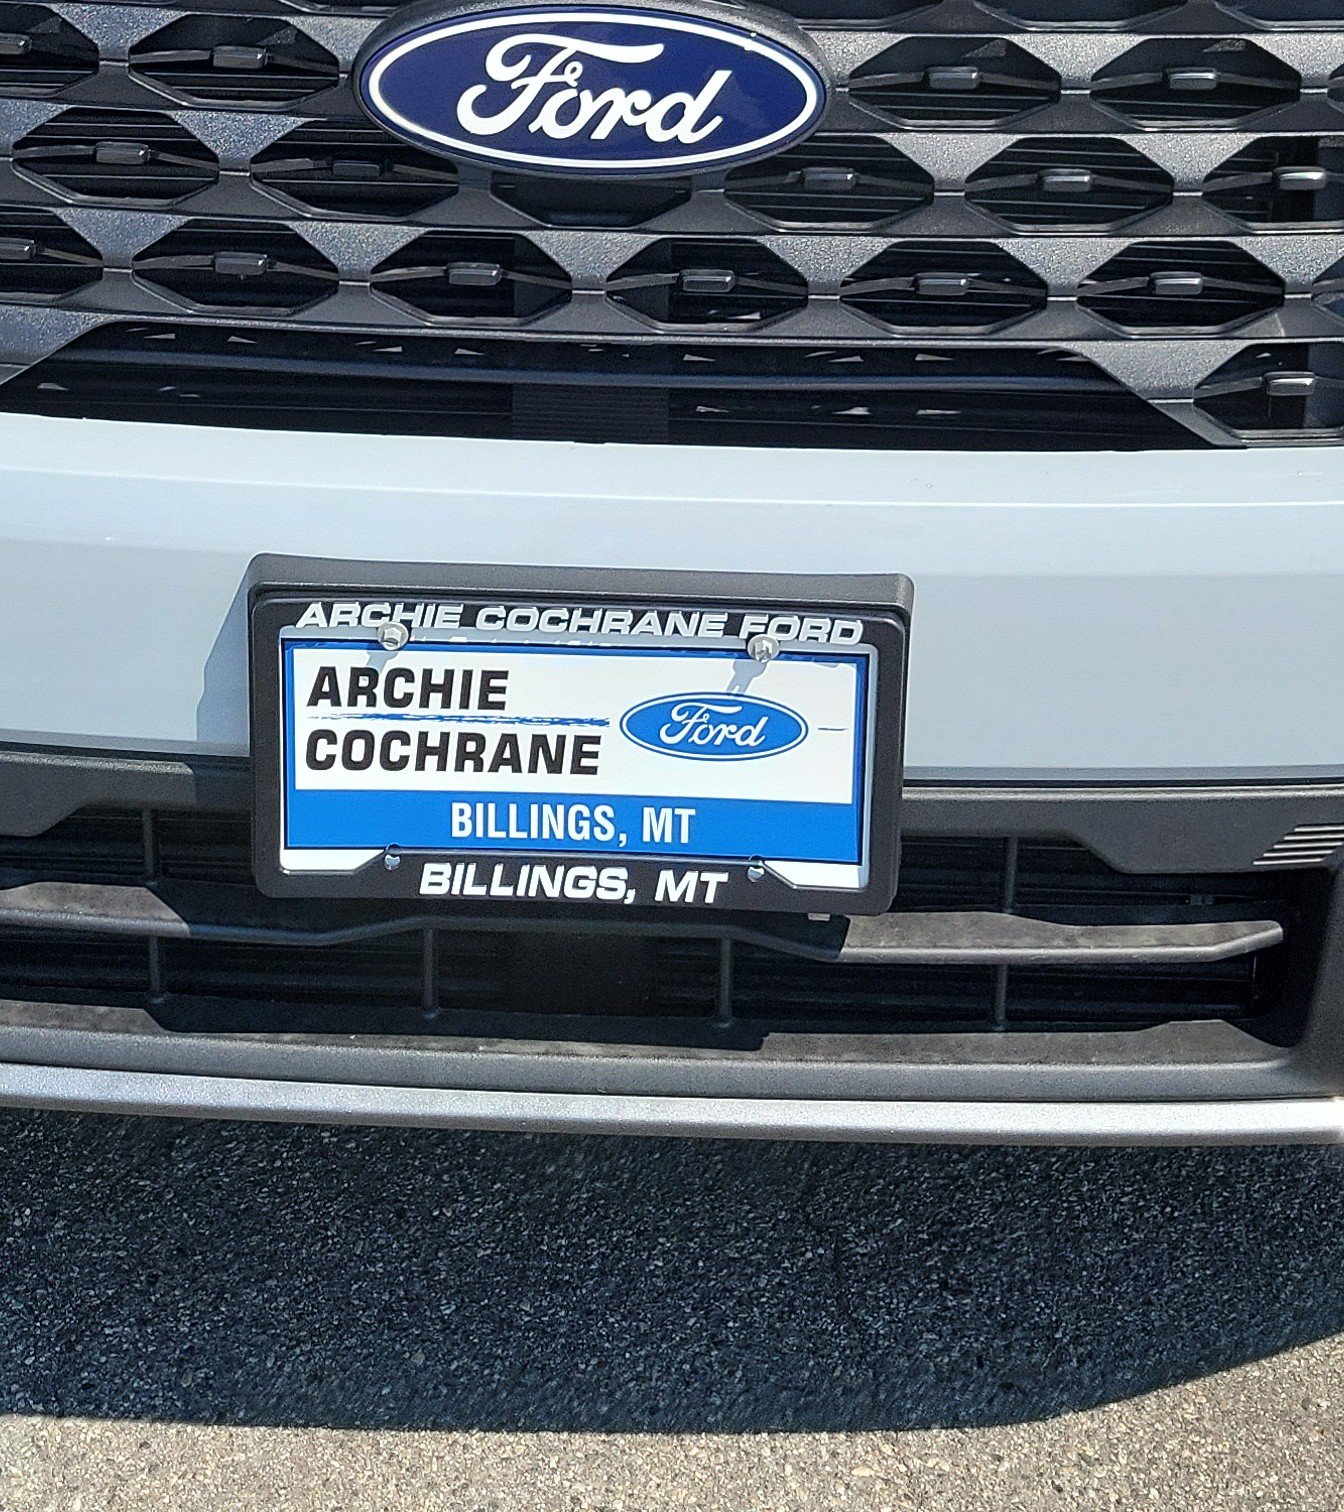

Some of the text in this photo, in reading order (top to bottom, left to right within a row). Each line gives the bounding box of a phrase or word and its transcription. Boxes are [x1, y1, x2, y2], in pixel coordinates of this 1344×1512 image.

[456, 33, 733, 145] Ford
[296, 601, 864, 646] ARCHIE COCHRANE FORD
[306, 665, 509, 711] ARCHIE
[659, 701, 769, 748] Ford
[305, 728, 602, 776] COCHRANE
[450, 802, 697, 847] BILLINGS, MT
[419, 862, 729, 905] BILLINGS, MT
